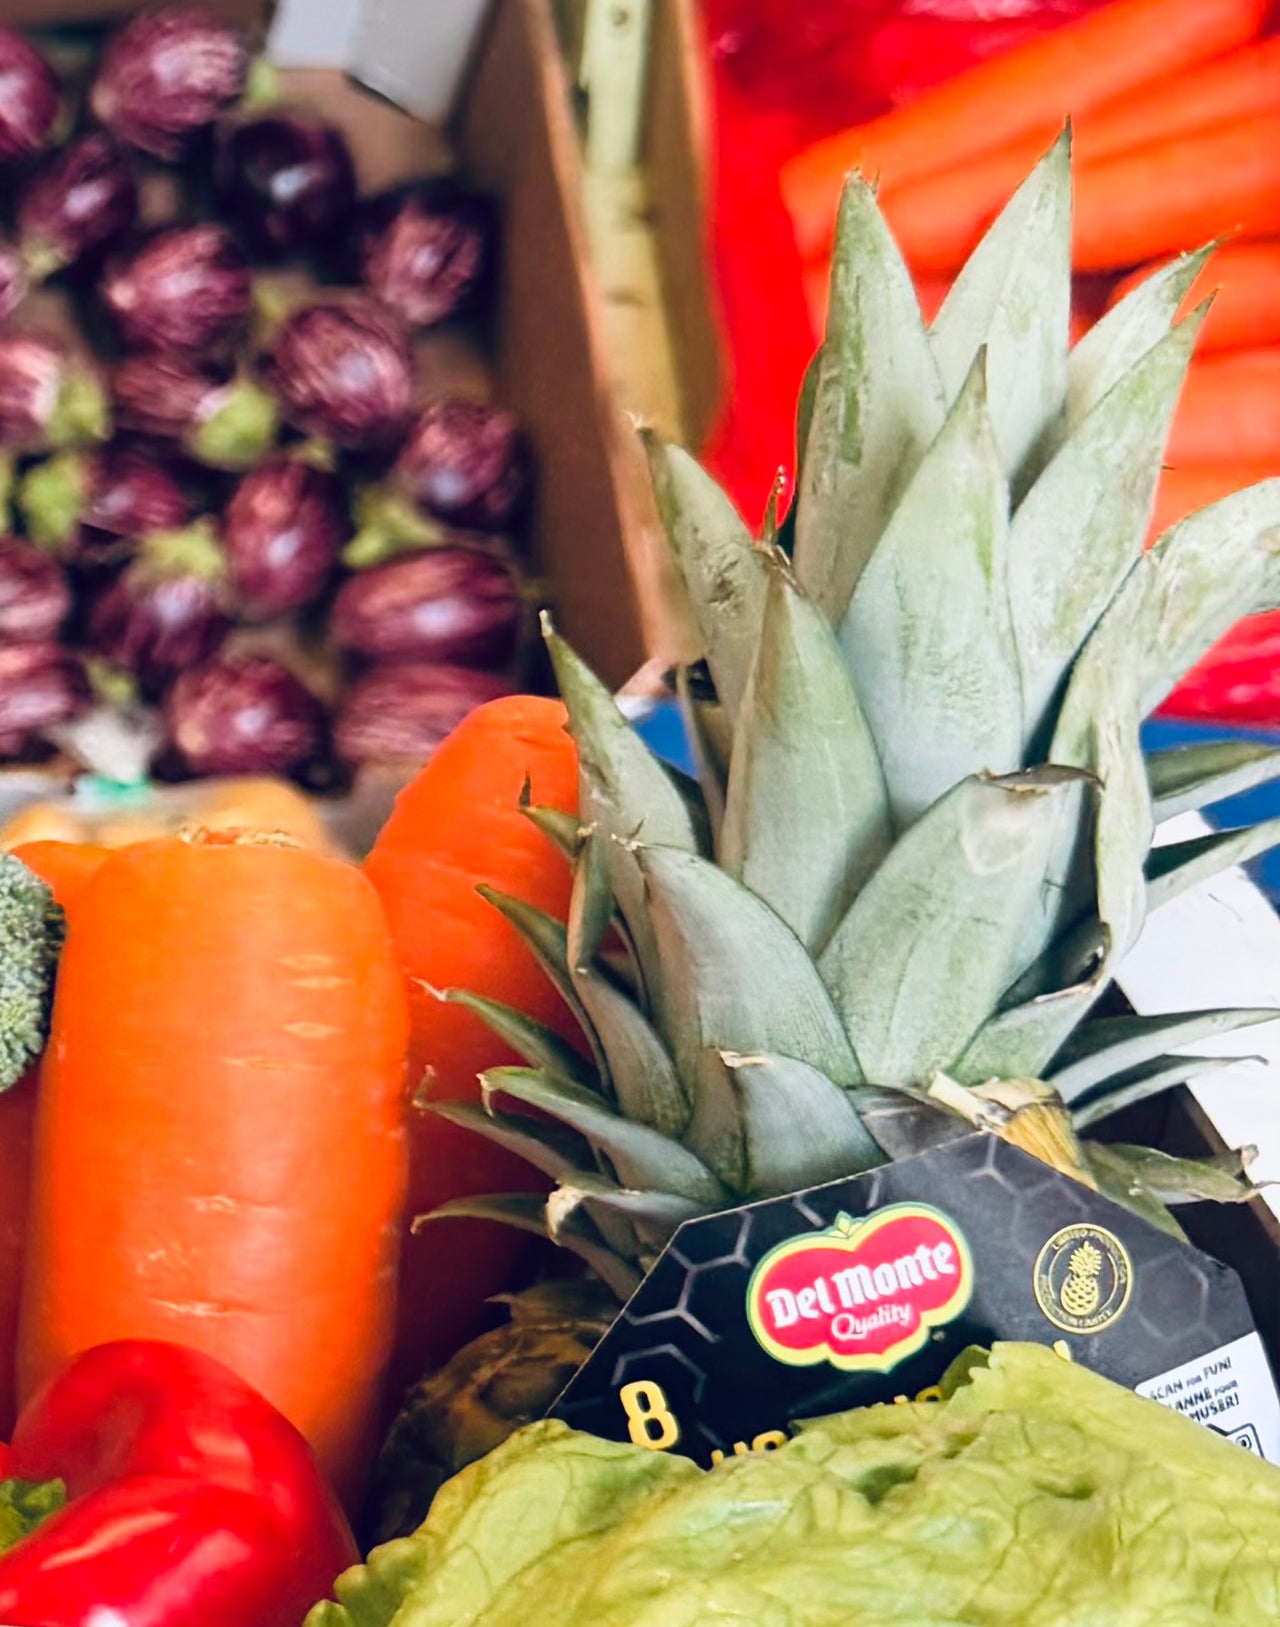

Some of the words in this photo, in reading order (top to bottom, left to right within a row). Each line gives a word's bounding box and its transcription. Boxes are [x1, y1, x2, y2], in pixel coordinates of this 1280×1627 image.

[766, 1277, 835, 1328] Del
[831, 1242, 957, 1307] Monte
[831, 1303, 912, 1340] Quality
[620, 1380, 679, 1450] 8
[1170, 1387, 1212, 1412] ANNE
[1189, 1392, 1239, 1422] MUSER!
